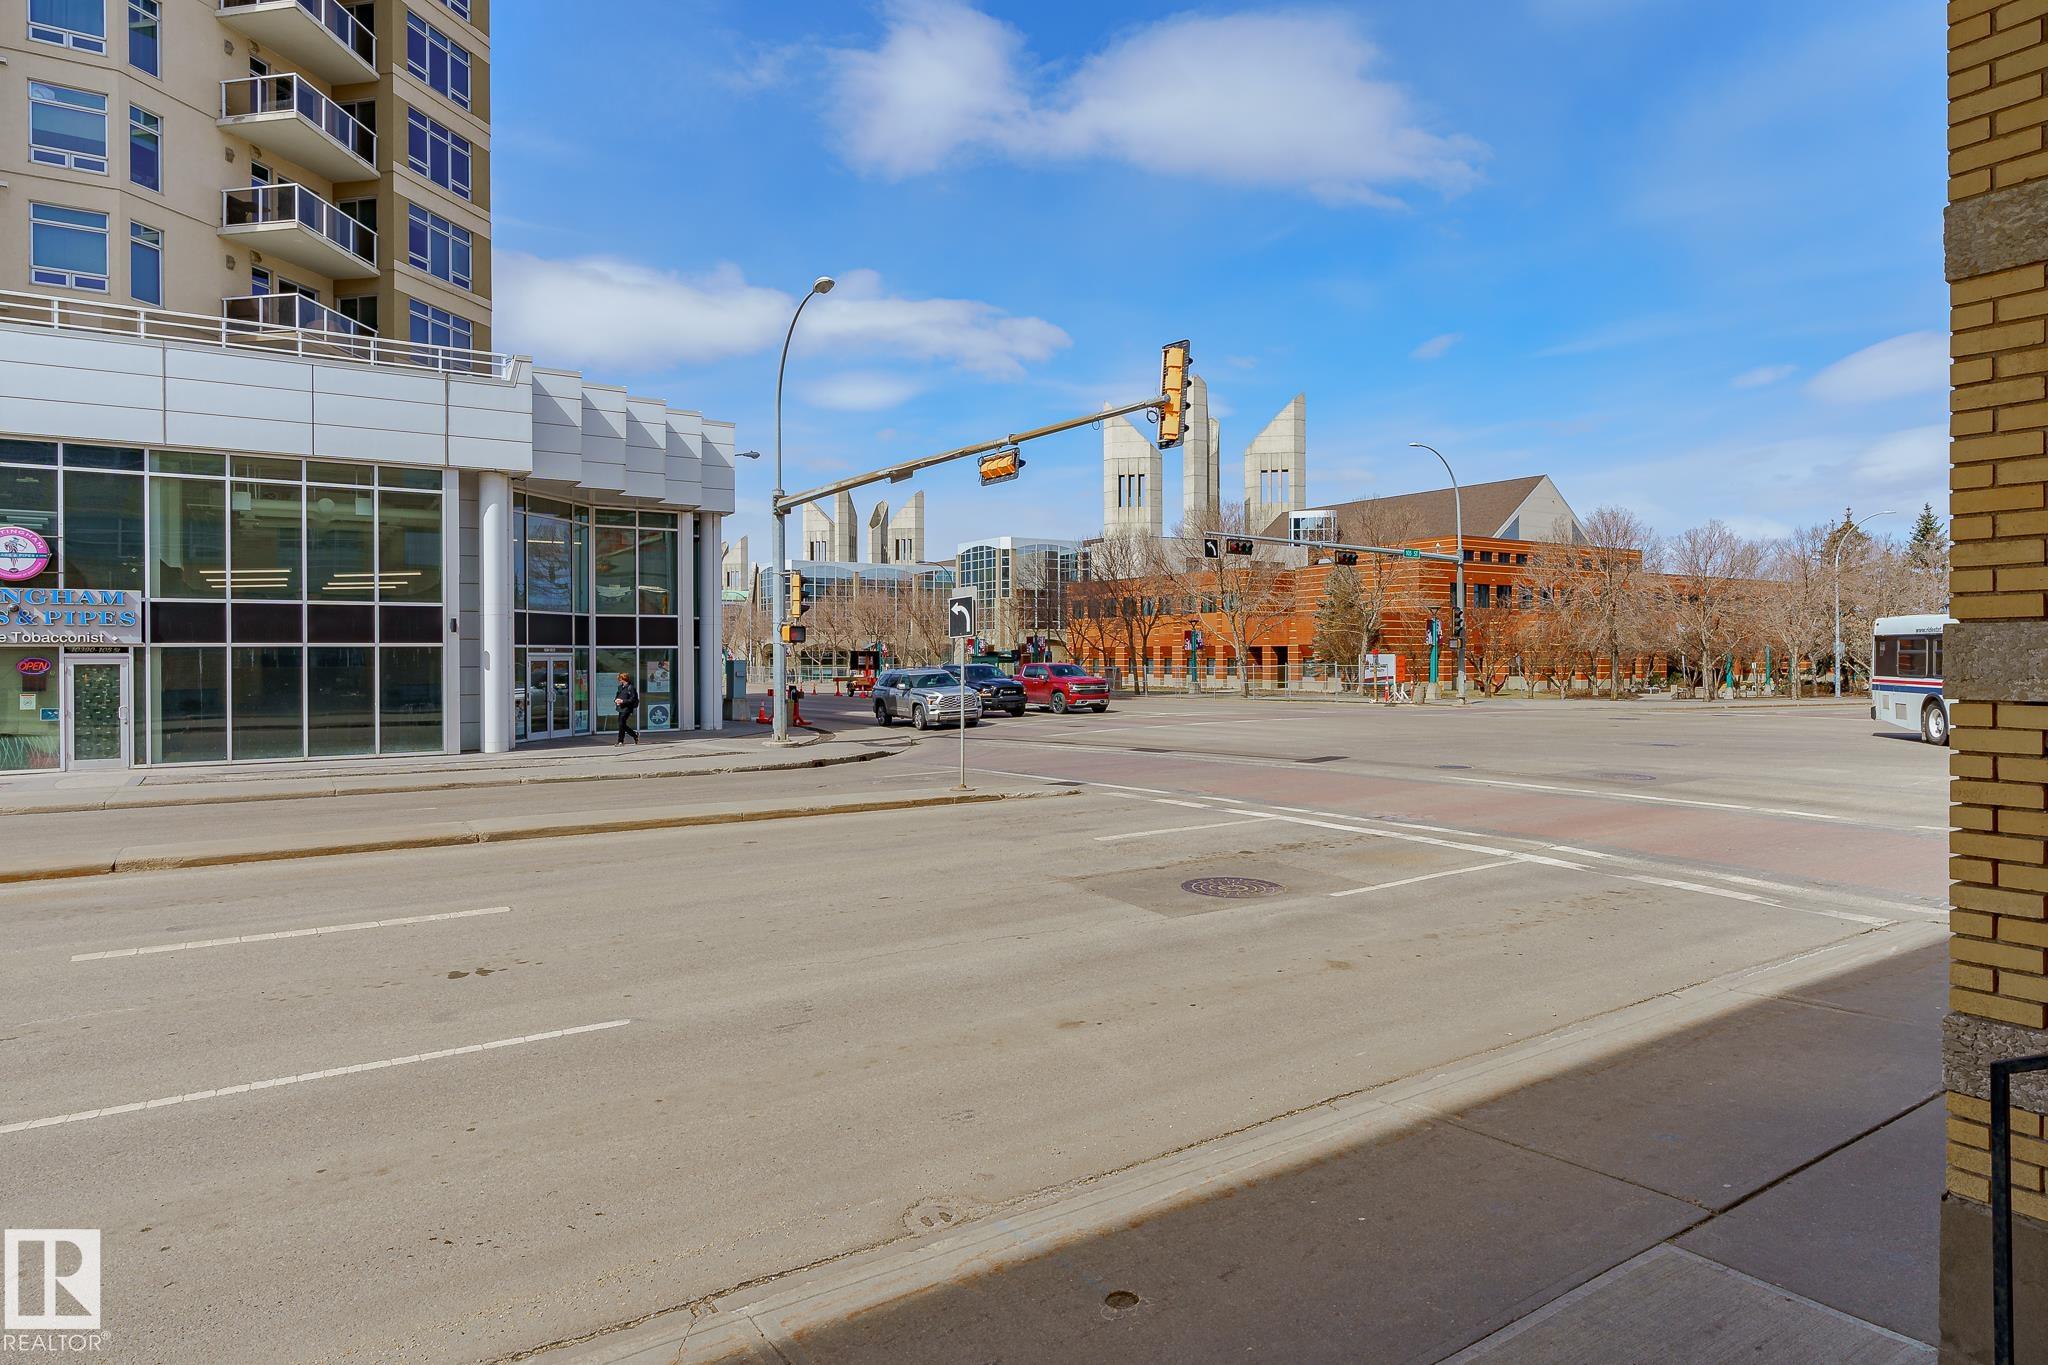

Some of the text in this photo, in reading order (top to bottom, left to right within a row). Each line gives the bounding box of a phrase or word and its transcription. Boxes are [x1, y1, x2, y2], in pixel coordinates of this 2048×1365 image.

[0, 588, 125, 606] NGHAM
[16, 608, 37, 626] &
[43, 609, 137, 627] PIPES
[11, 631, 105, 644] Tobacconist
[20, 661, 48, 671] OPEN
